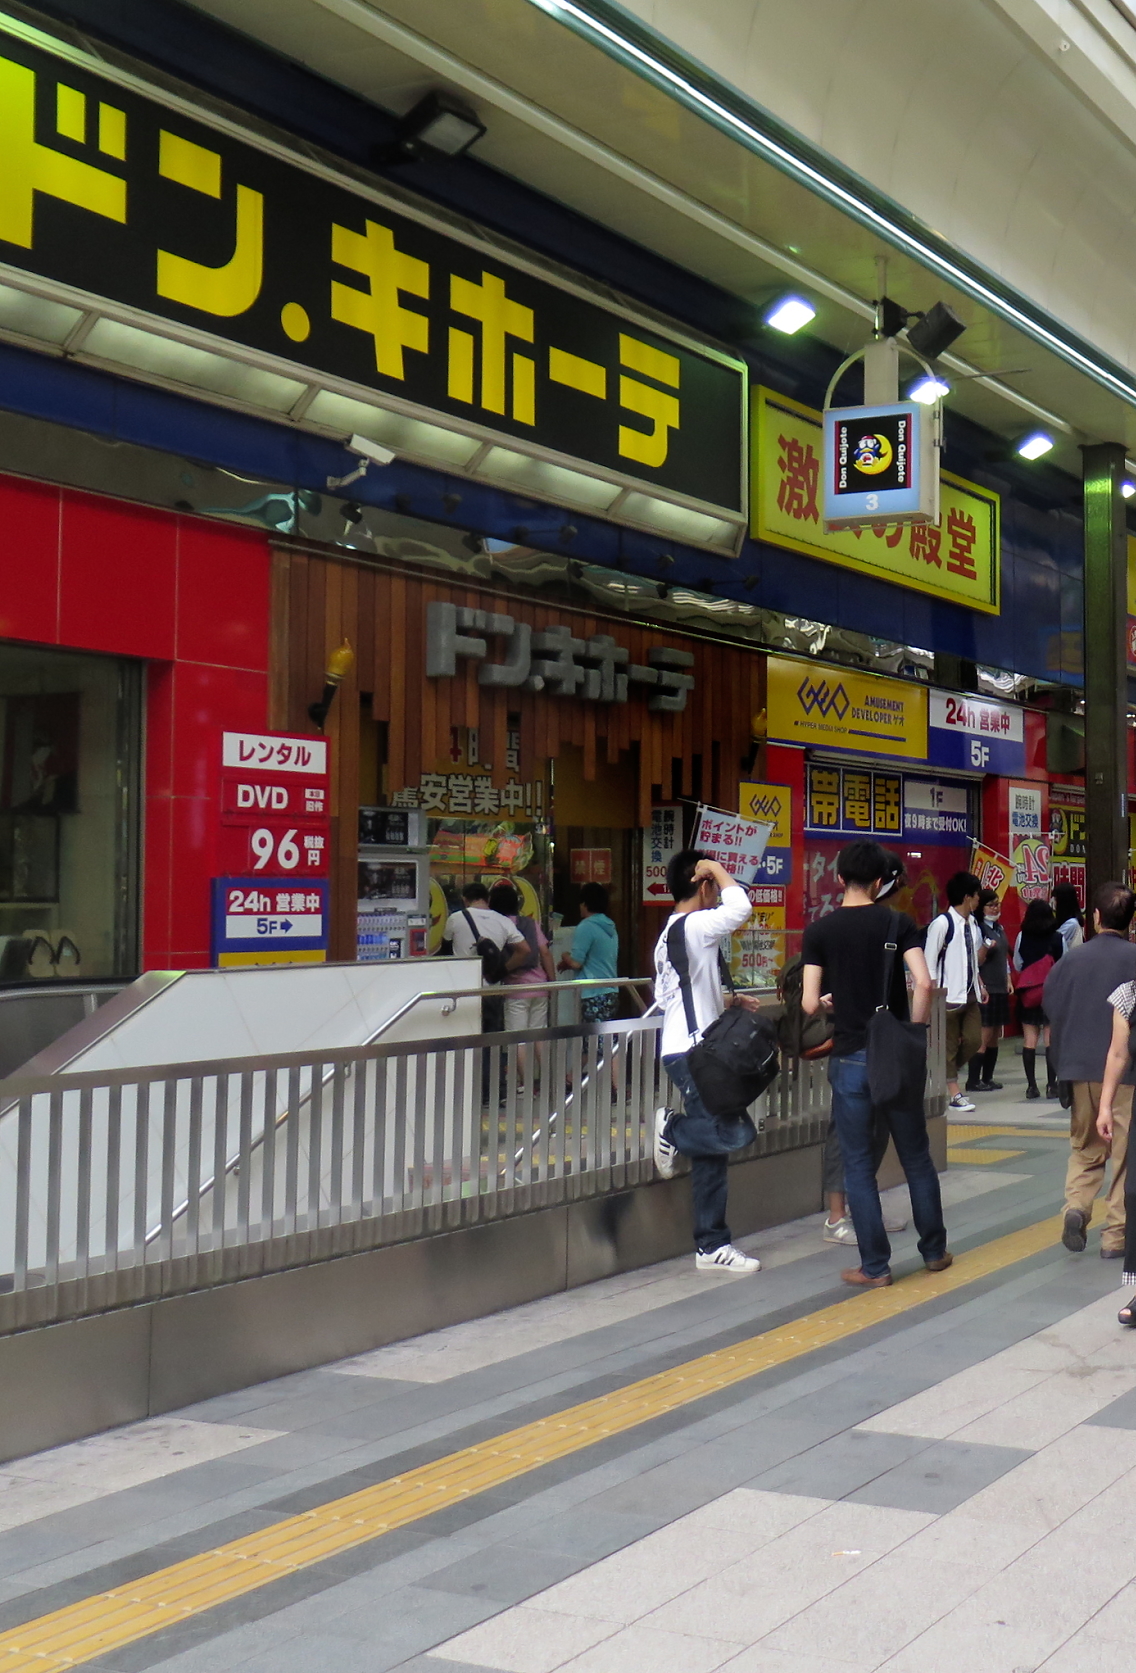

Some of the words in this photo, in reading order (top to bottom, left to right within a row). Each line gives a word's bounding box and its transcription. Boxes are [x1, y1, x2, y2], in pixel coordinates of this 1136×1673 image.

[897, 420, 907, 442] Don
[838, 426, 848, 466] Quijote
[897, 444, 907, 484] Quijote
[838, 469, 848, 489] Don
[865, 494, 879, 511] 3
[797, 676, 850, 721] GEO
[864, 695, 905, 713] AMUSEMENT
[851, 707, 893, 725] DEVELOPER
[945, 697, 976, 729] 24h
[979, 707, 1011, 735] 営業中
[799, 720, 818, 730] HYPER
[833, 724, 848, 734] SHOP
[238, 739, 312, 767] レンタル
[970, 739, 990, 768] 5F
[236, 784, 289, 810] DVD
[749, 794, 782, 817] GEO
[929, 787, 944, 808] 1F
[701, 819, 758, 837] ポイントが
[1012, 811, 1039, 829] 電池交換
[303, 835, 325, 850] 税抜
[651, 810, 663, 863] 電池交換
[700, 831, 743, 847] 貯まる!!
[251, 828, 301, 870] 96
[307, 850, 321, 867] 円
[767, 855, 784, 875] 5F
[229, 890, 272, 913] 24h
[275, 892, 320, 913] 営業中
[256, 917, 278, 935] 5F
